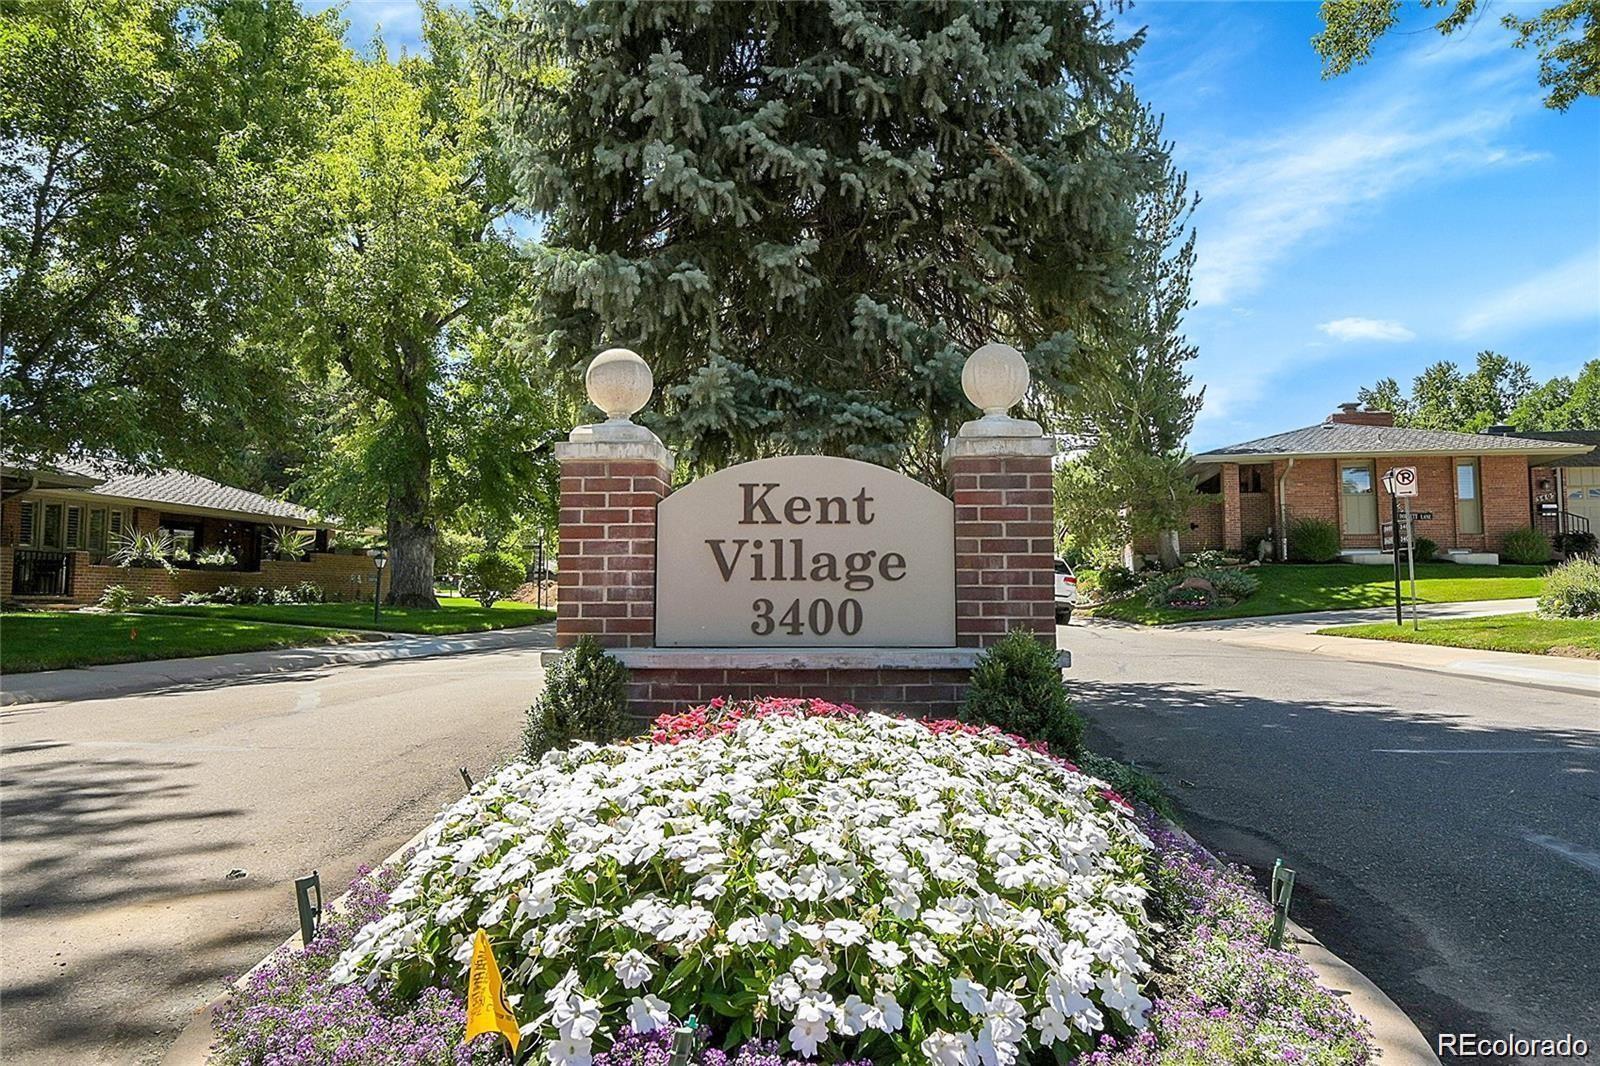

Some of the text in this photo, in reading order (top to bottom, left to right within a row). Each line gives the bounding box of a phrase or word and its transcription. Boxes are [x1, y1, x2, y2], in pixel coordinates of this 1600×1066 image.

[738, 482, 875, 525] Kent
[705, 538, 907, 592] Village
[750, 598, 863, 636] 3400
